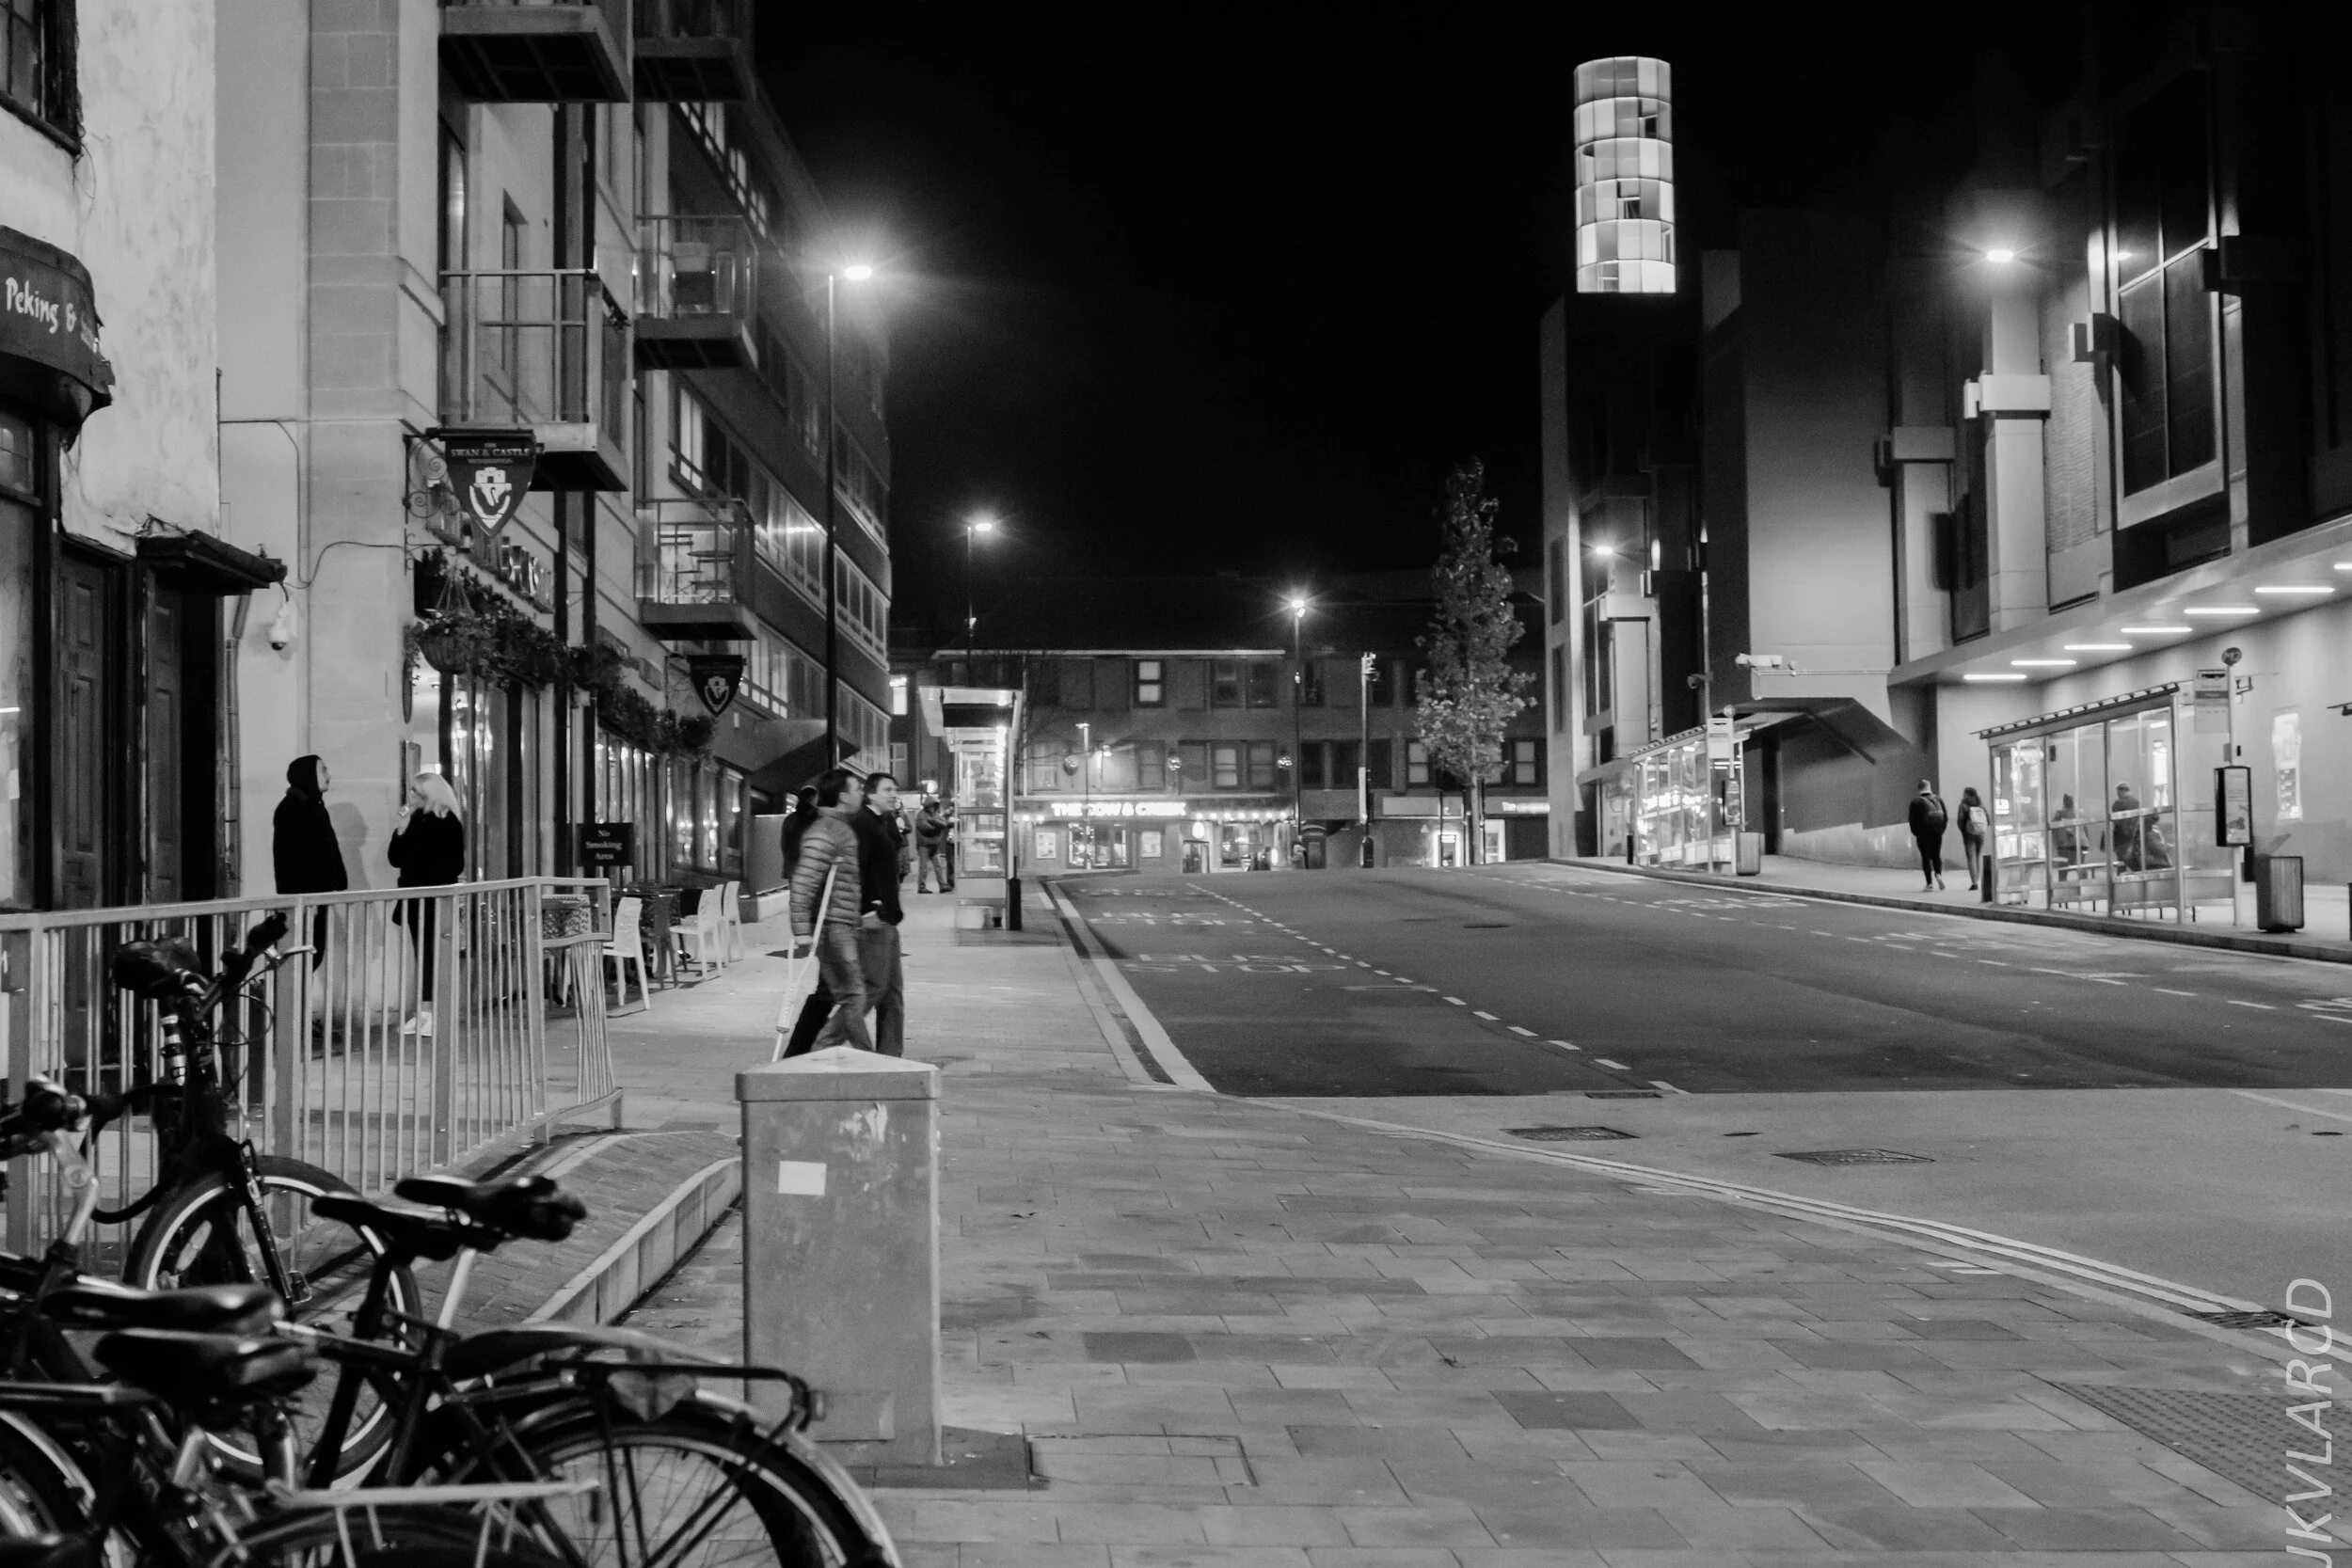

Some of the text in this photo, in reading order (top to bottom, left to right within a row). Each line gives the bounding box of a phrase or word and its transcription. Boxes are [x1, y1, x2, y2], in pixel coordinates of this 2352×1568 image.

[5, 277, 59, 335] Peking
[65, 302, 77, 332] &
[451, 449, 480, 457] SWAN
[492, 448, 531, 457] CASTLE
[585, 841, 622, 850] Smoking
[1124, 963, 1348, 974] STOP
